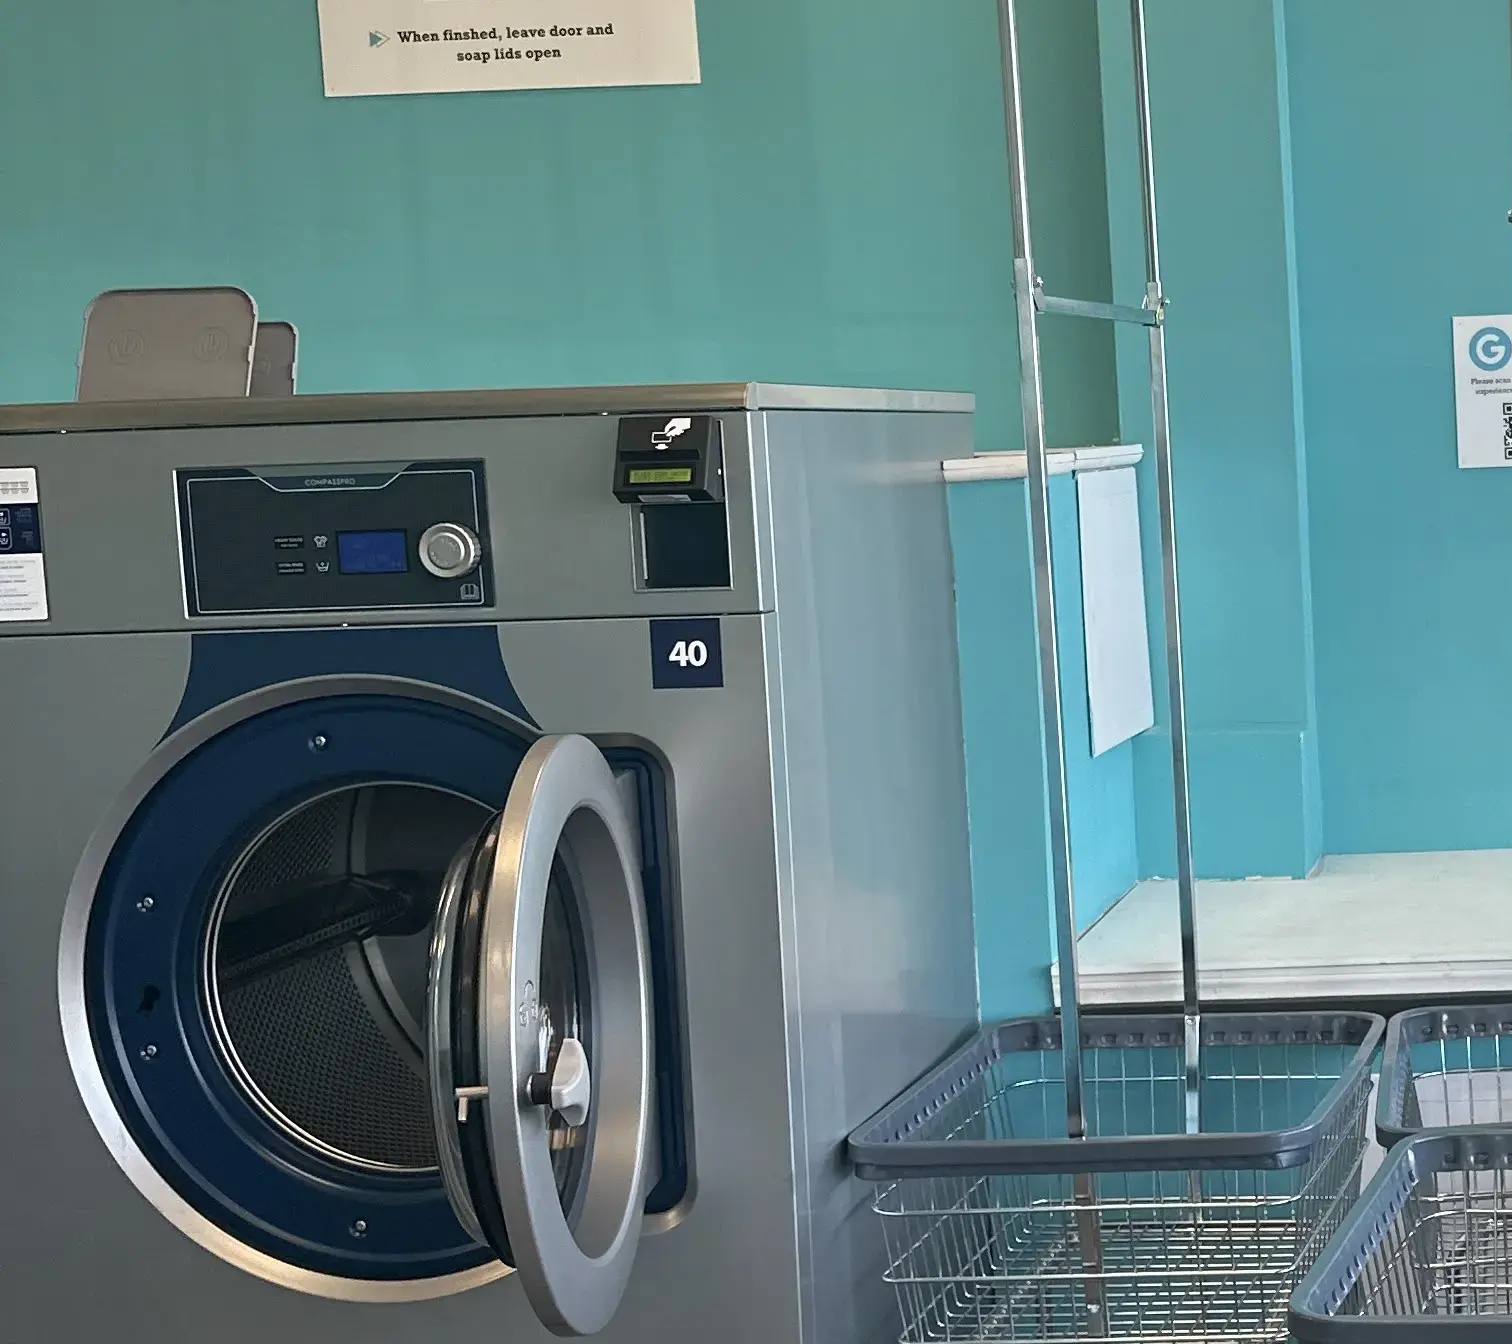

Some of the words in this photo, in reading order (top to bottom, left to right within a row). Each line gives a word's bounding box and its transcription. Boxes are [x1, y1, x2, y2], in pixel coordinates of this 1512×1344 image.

[397, 30, 440, 43] When
[506, 26, 546, 39] leave
[549, 24, 583, 37] door
[586, 23, 615, 36] and
[456, 50, 491, 64] soap
[494, 47, 522, 60] lids
[525, 48, 562, 62] open
[668, 640, 708, 667] 40
